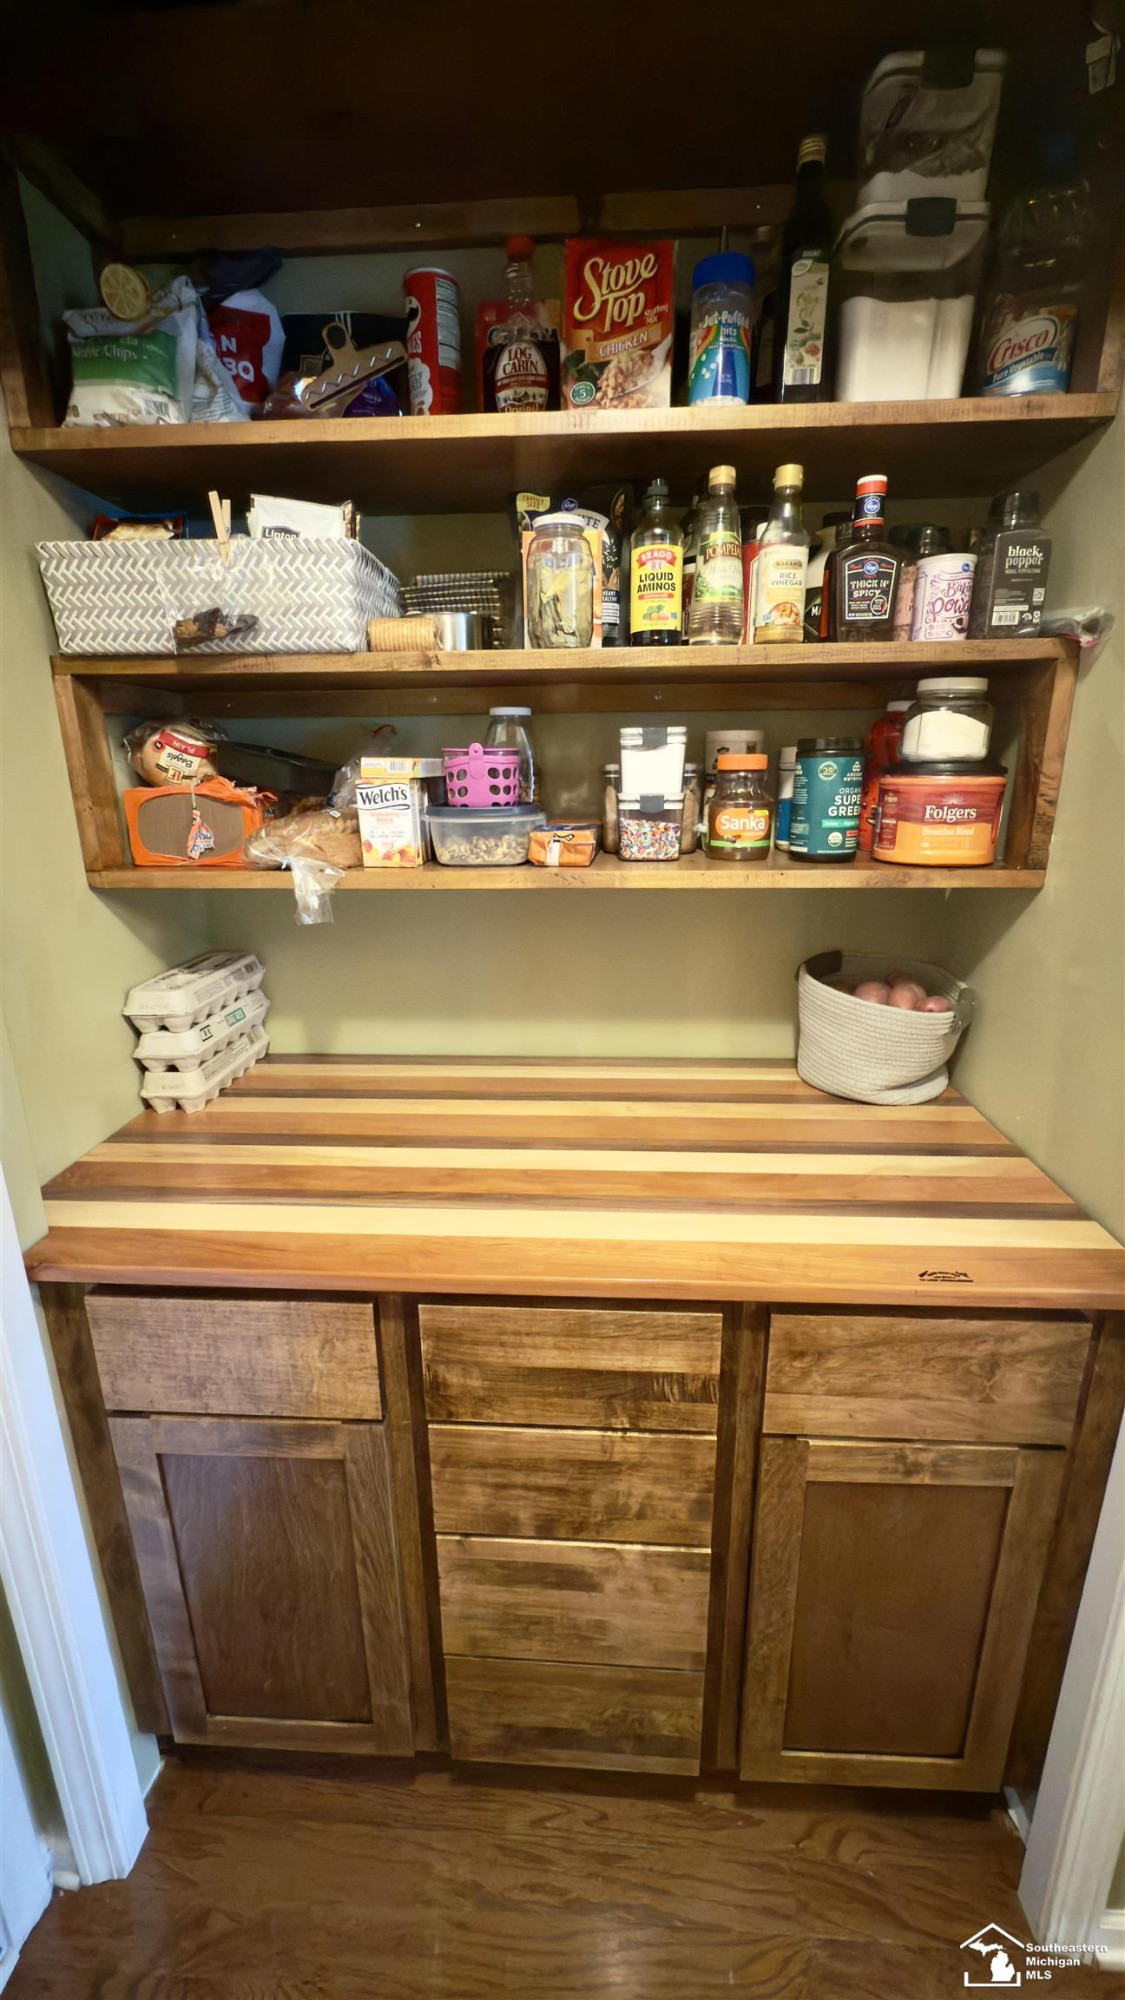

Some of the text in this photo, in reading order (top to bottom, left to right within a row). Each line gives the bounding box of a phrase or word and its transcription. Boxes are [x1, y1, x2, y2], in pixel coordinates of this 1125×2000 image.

[573, 252, 658, 322] Stove
[603, 291, 646, 334] Top
[720, 325, 737, 336] bits
[600, 331, 648, 358] CHICKEN
[988, 329, 1050, 372] Crisco
[104, 344, 138, 362] Chips
[507, 346, 532, 361] LOG
[502, 360, 539, 376] CABIN
[579, 389, 587, 398] 5
[264, 528, 297, 539] Lipton
[640, 550, 673, 563] BRAGG
[705, 542, 742, 560] POMPEIA
[1007, 545, 1043, 557] black
[1004, 557, 1044, 569] pepper
[639, 572, 674, 583] LIQUID
[636, 583, 677, 593] AMINOS
[849, 580, 878, 589] THICK
[852, 590, 881, 599] SPICY
[172, 740, 196, 754] PLAIN
[166, 752, 194, 768] Bagels
[822, 766, 834, 776] 25
[359, 786, 408, 806] Welch's
[839, 787, 861, 795] ORGAN
[834, 795, 861, 806] SUPE
[828, 806, 860, 817] GREE
[924, 805, 977, 822] Folgers
[720, 815, 766, 831] Sanka
